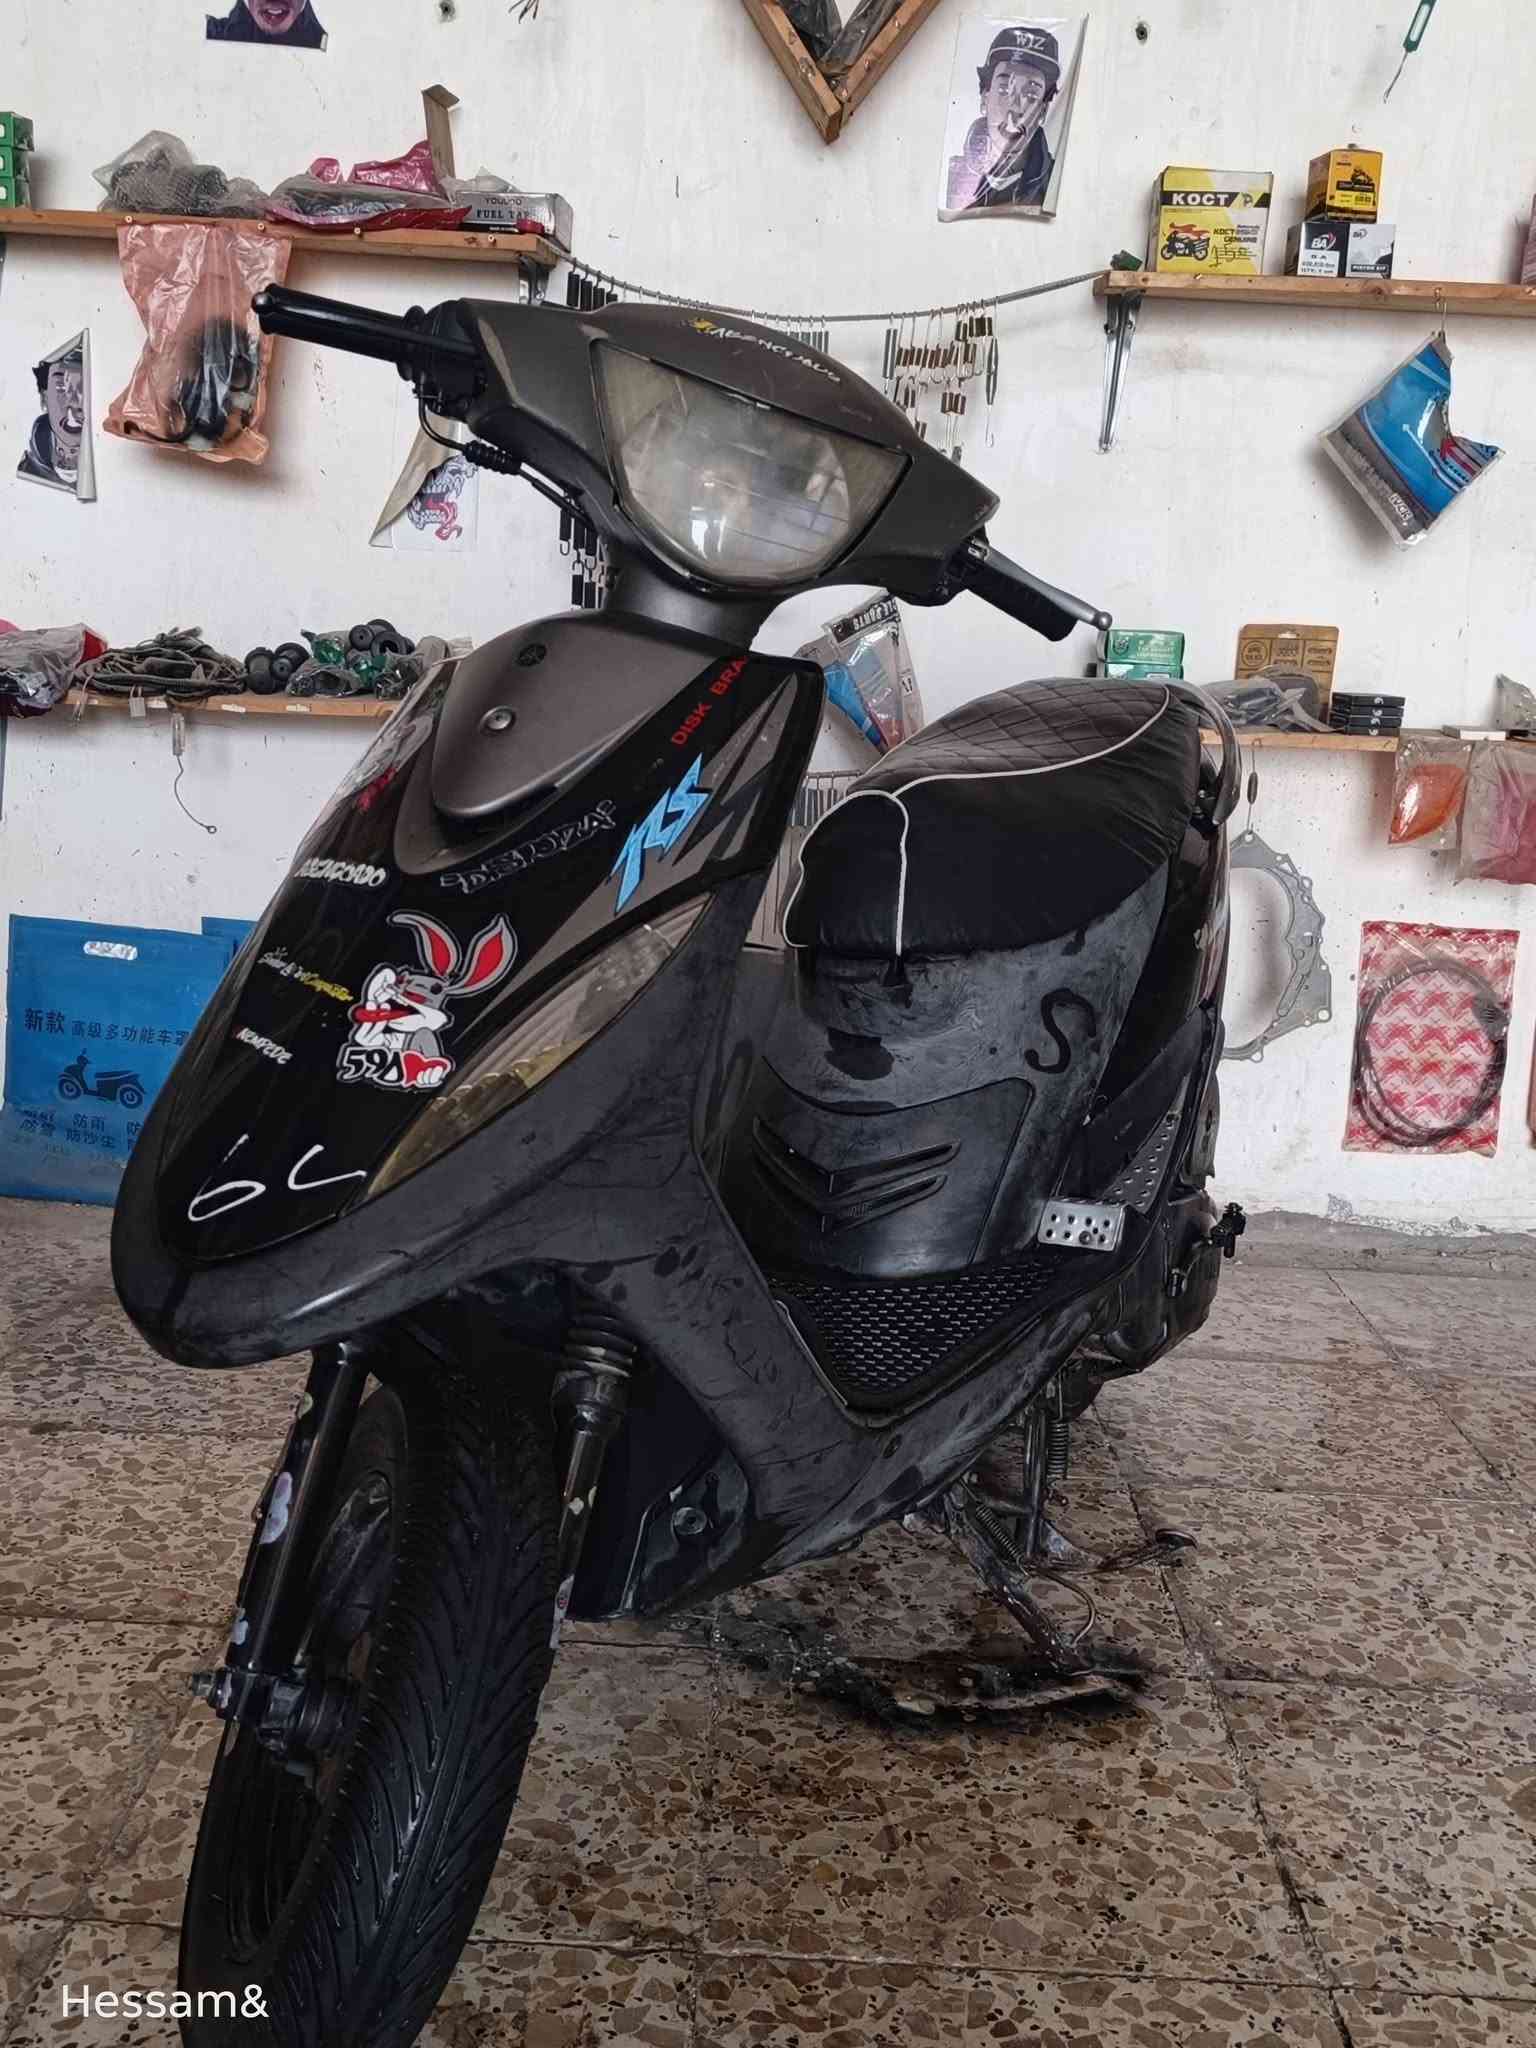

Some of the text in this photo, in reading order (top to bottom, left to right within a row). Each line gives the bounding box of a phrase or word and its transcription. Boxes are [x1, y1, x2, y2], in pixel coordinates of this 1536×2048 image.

[1172, 192, 1229, 207] KOCT
[476, 209, 505, 219] FUEL
[671, 701, 713, 746] DISK
[24, 1008, 65, 1033] 新款
